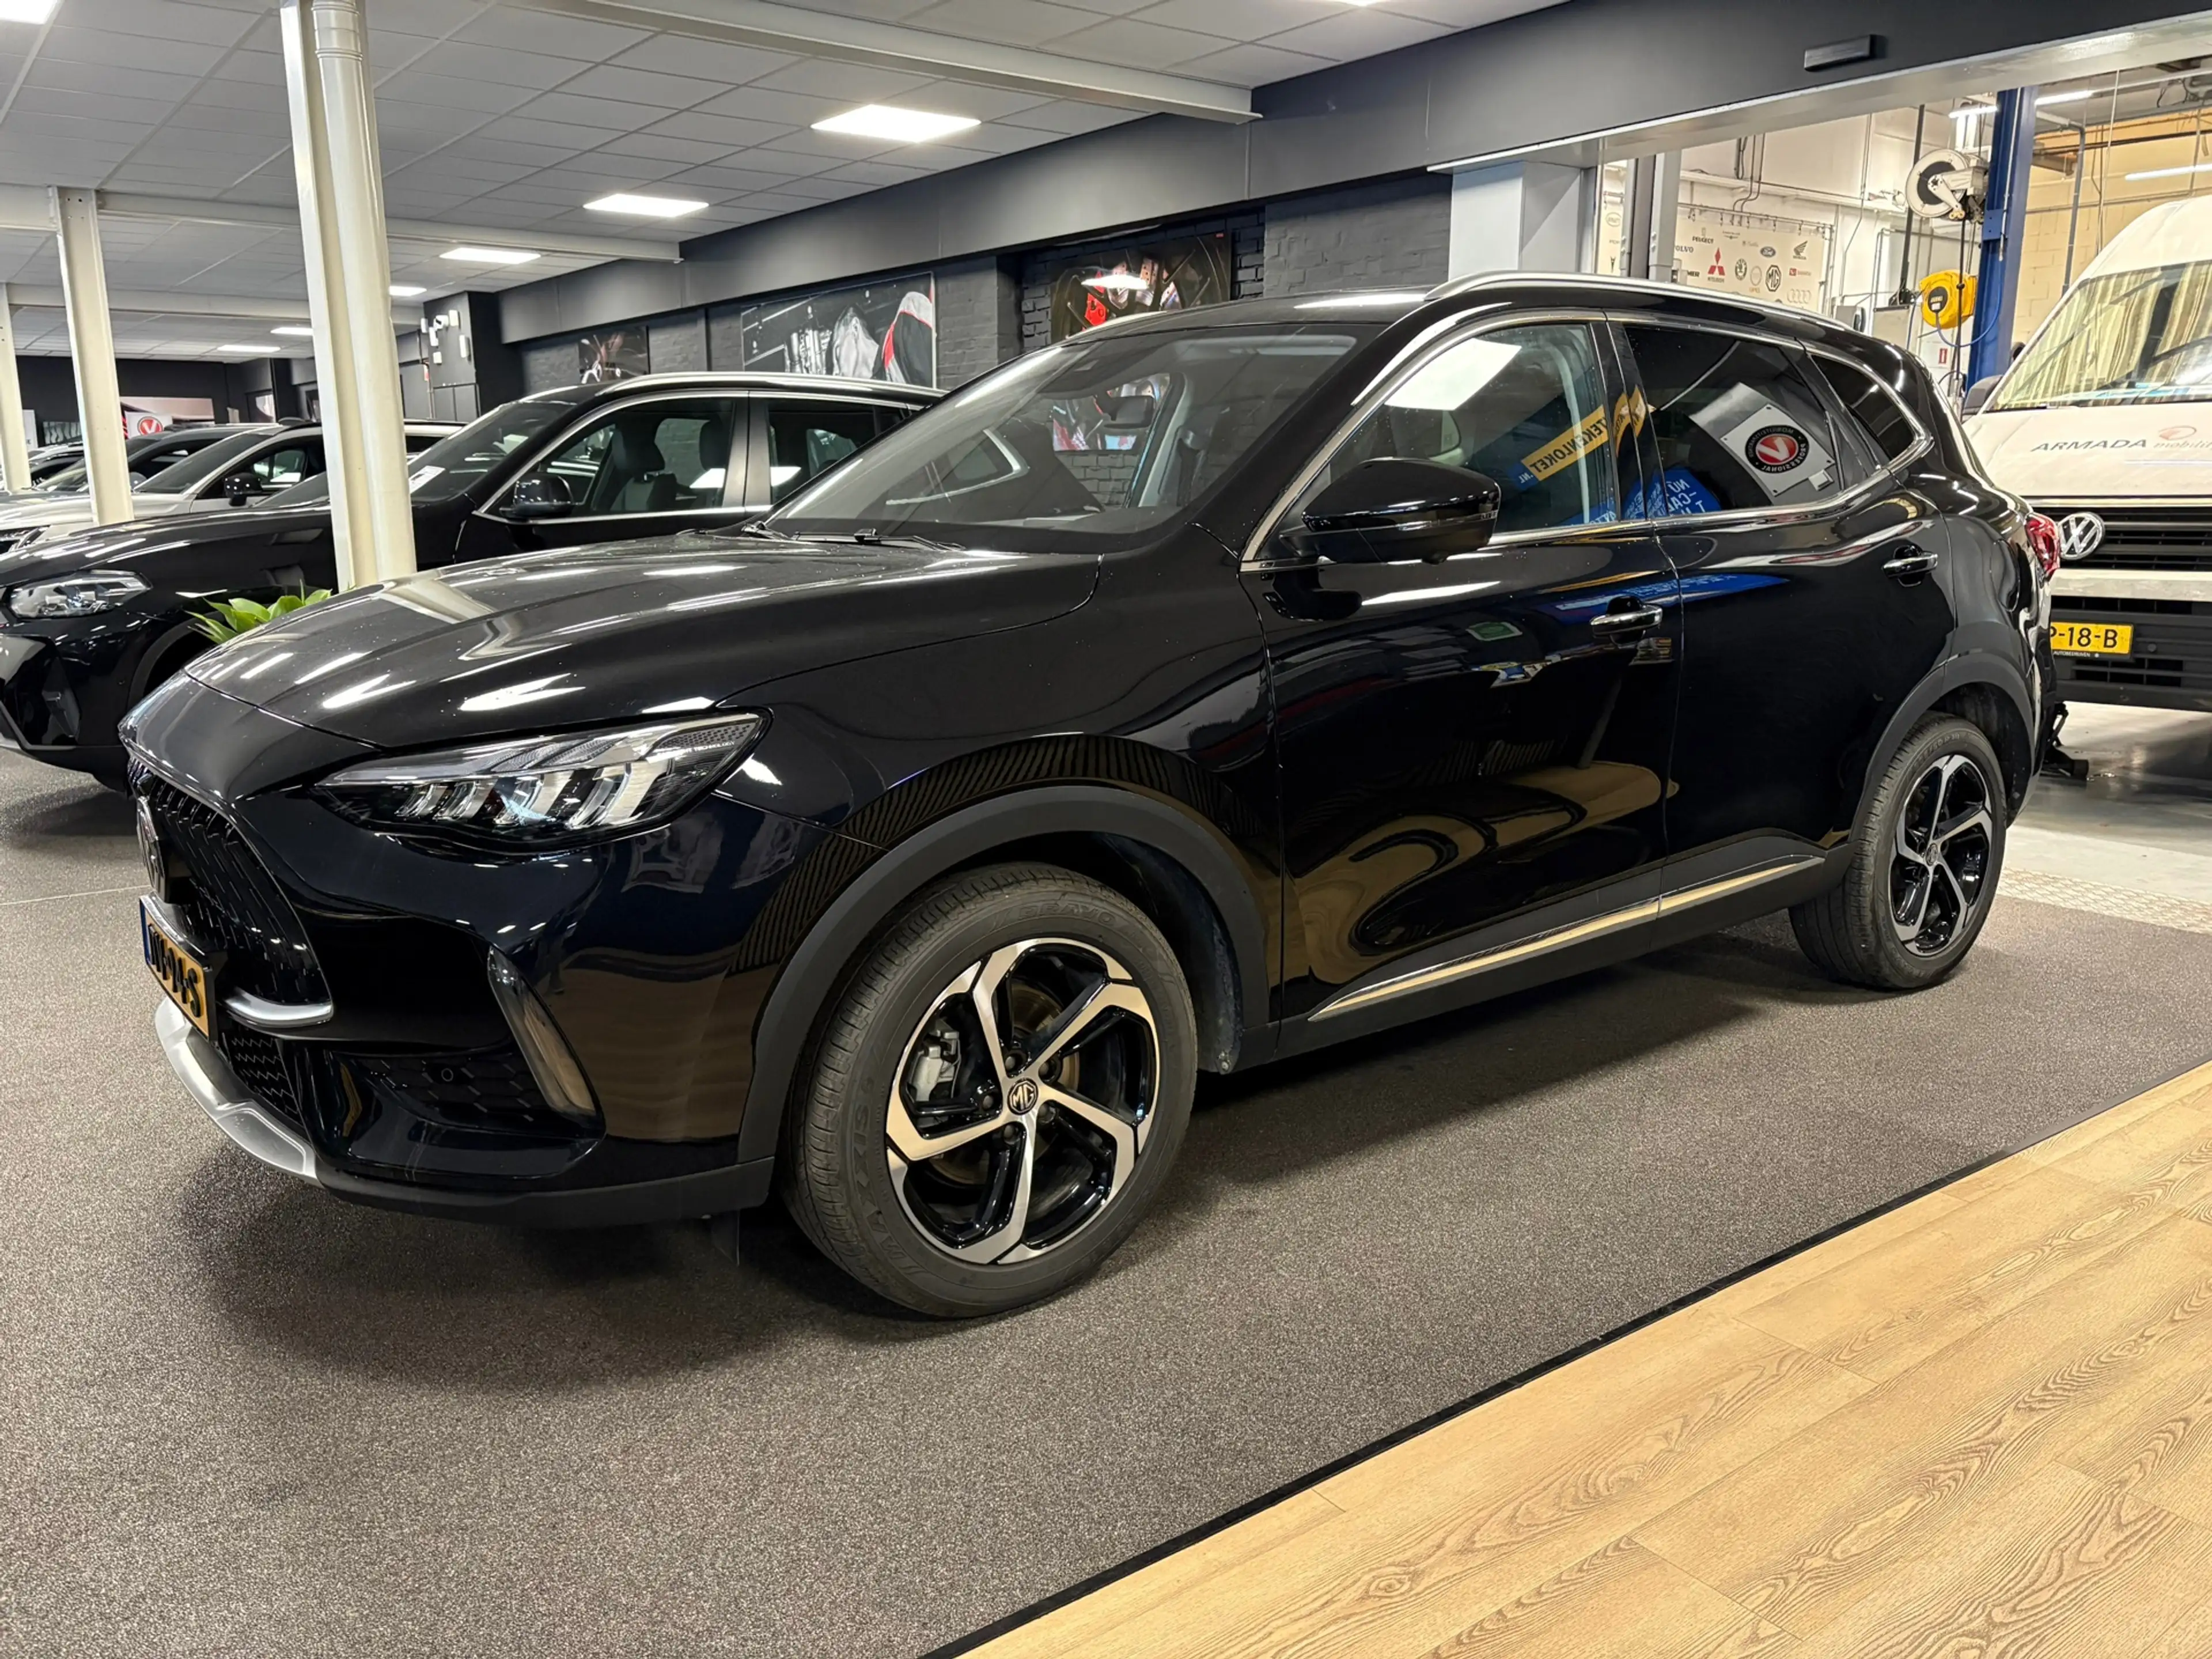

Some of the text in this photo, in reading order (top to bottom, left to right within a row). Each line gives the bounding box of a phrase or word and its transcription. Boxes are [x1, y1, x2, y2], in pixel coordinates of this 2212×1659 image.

[2030, 439, 2146, 452] ARMADA
[1012, 1083, 1035, 1112] MG
[854, 1104, 907, 1260] MAXXIS
